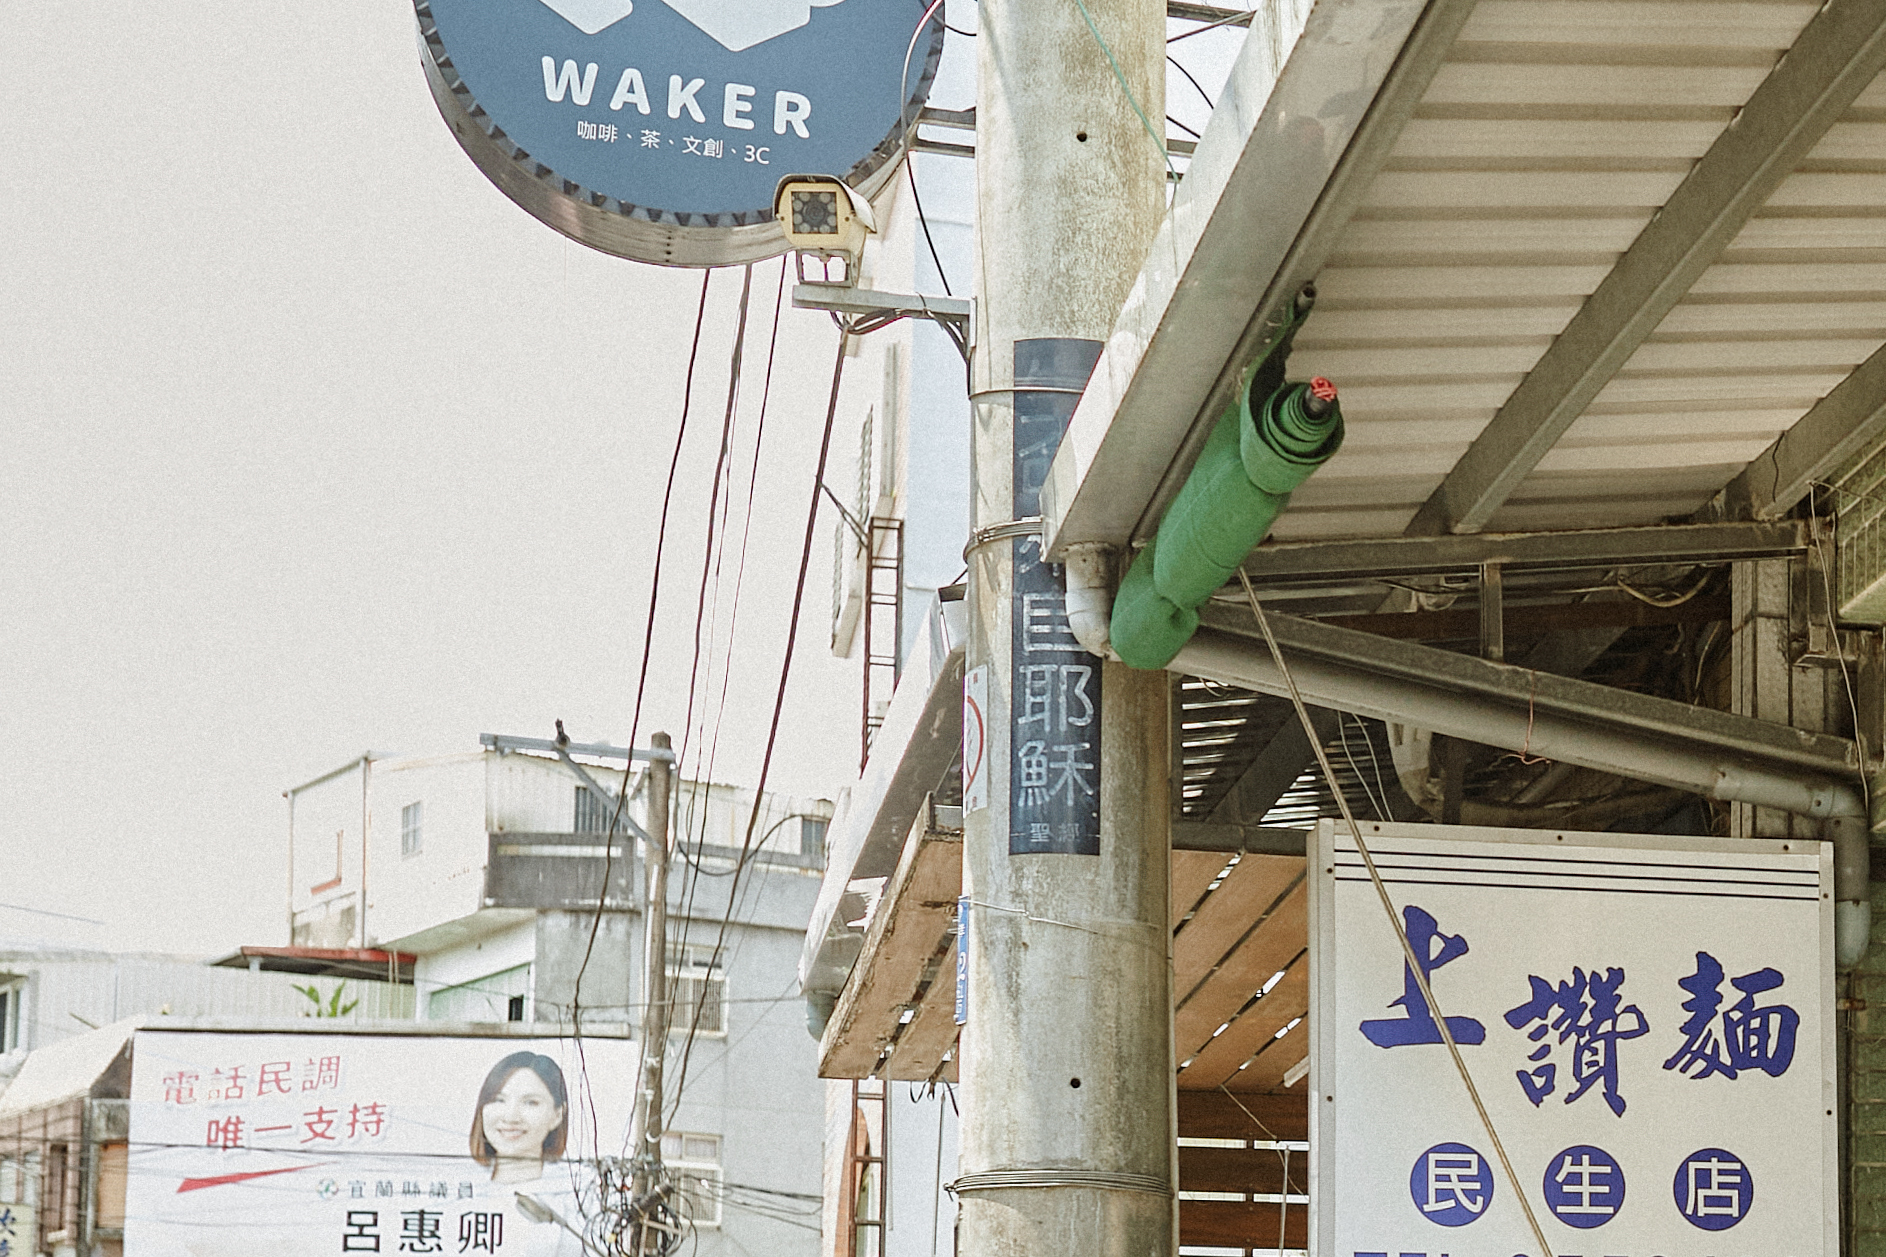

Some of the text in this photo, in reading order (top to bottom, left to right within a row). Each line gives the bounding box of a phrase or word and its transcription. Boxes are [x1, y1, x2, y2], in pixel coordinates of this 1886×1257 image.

[541, 55, 813, 138] WAKER
[1359, 905, 1800, 1118] 上讚麵
[161, 1054, 343, 1106] 電話民調
[206, 1102, 388, 1152] 唯一支持
[1422, 1151, 1745, 1218] 民生店
[342, 1208, 504, 1255] 呂惠卿
